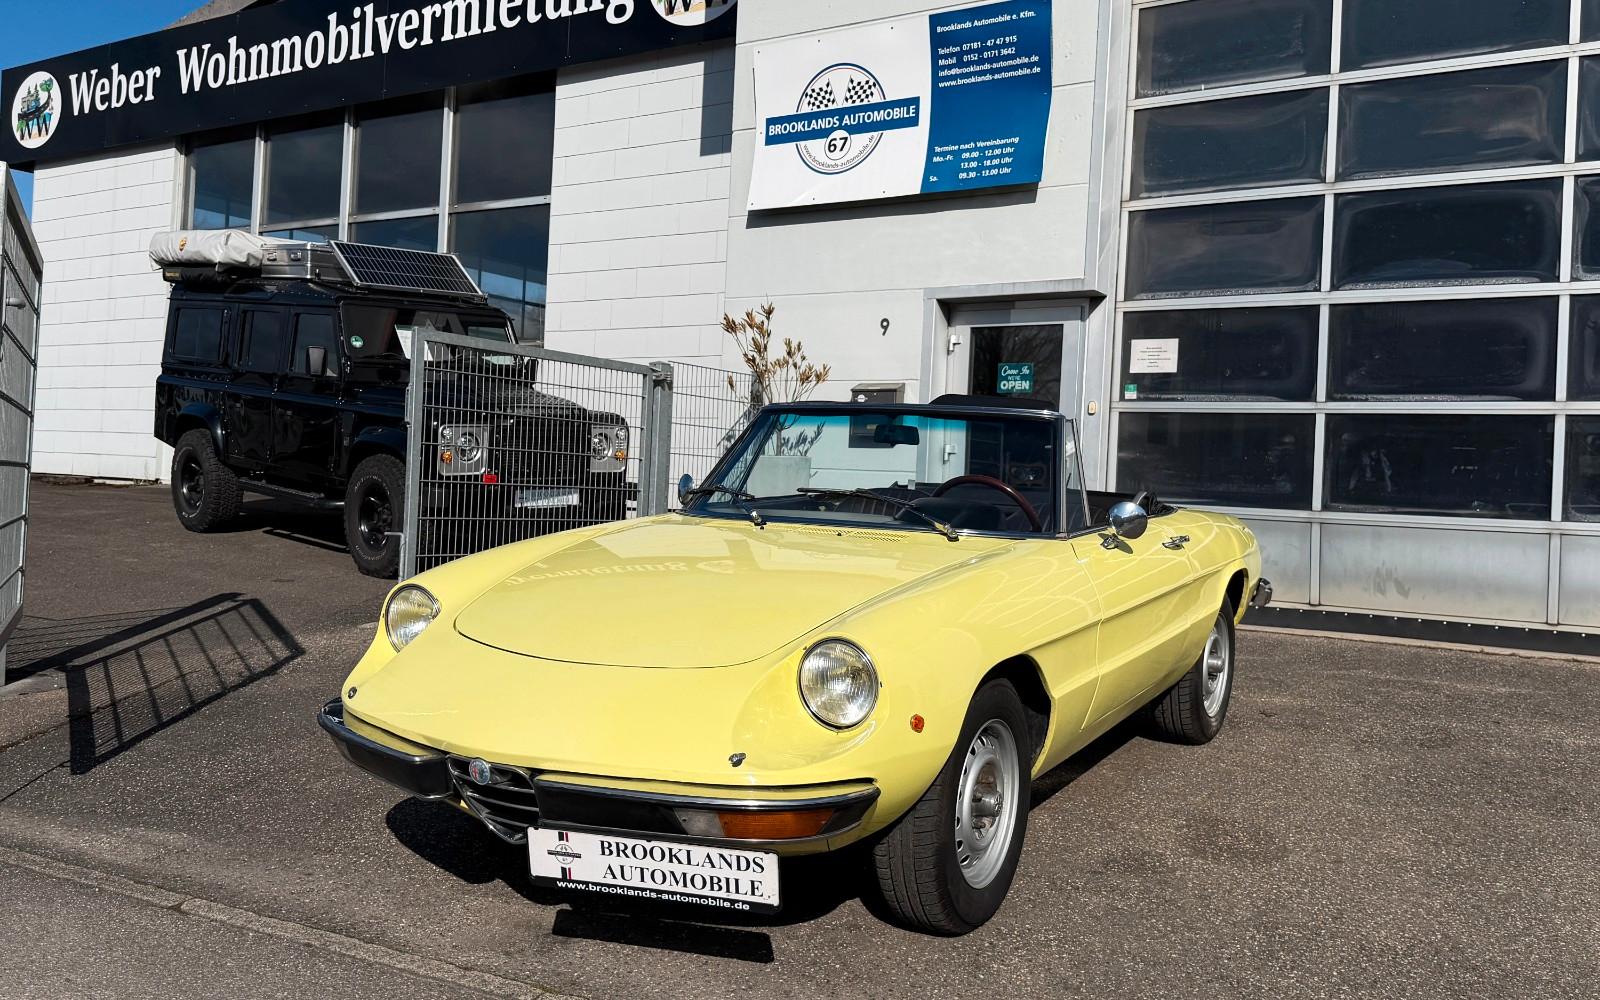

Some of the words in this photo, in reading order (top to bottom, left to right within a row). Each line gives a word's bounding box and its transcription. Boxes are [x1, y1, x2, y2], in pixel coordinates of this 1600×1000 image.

[937, 22, 972, 32] Brooklands
[973, 14, 1010, 26] Automobile
[1020, 10, 1036, 18] Kfm.
[938, 46, 960, 54] Telefon
[962, 42, 981, 50] 07181
[939, 57, 956, 66] Mobil
[963, 54, 978, 62] 0152
[984, 50, 998, 58] 0171
[939, 54, 1039, 76] info@brooklands-automobile.de
[939, 66, 1040, 87] www.brooklands-automobile.de
[69, 62, 161, 116] Weber
[769, 116, 839, 136] BROOKLANDS
[842, 105, 916, 126] AUTOMOBILE
[803, 134, 875, 169] www.brooklands-automobile.de
[827, 136, 848, 153] 67
[977, 137, 1019, 147] Vereinbarung
[880, 318, 890, 336] 9
[1002, 366, 1018, 376] Come
[1020, 366, 1029, 374] In
[1001, 381, 1030, 390] OPEN
[600, 840, 764, 874] BROOKLANDS
[602, 864, 764, 897] AUTOMOBILE
[556, 880, 750, 910] www.brooklands-automobile.de
